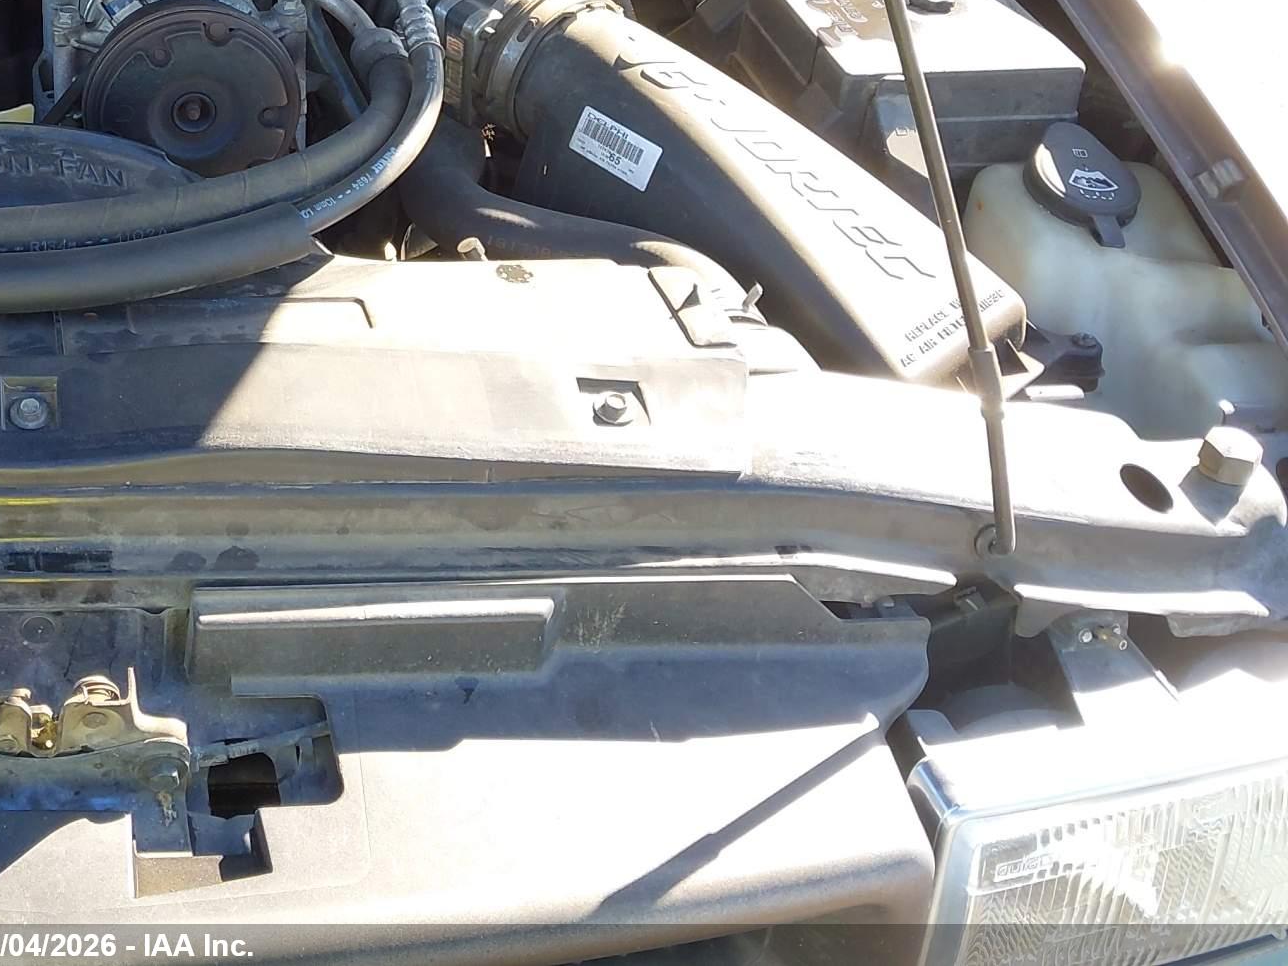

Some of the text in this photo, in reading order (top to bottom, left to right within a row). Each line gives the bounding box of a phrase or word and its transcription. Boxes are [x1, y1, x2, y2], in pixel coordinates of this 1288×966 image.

[587, 112, 629, 139] DELPHI
[608, 153, 622, 165] 65
[937, 314, 967, 340] FILTE
